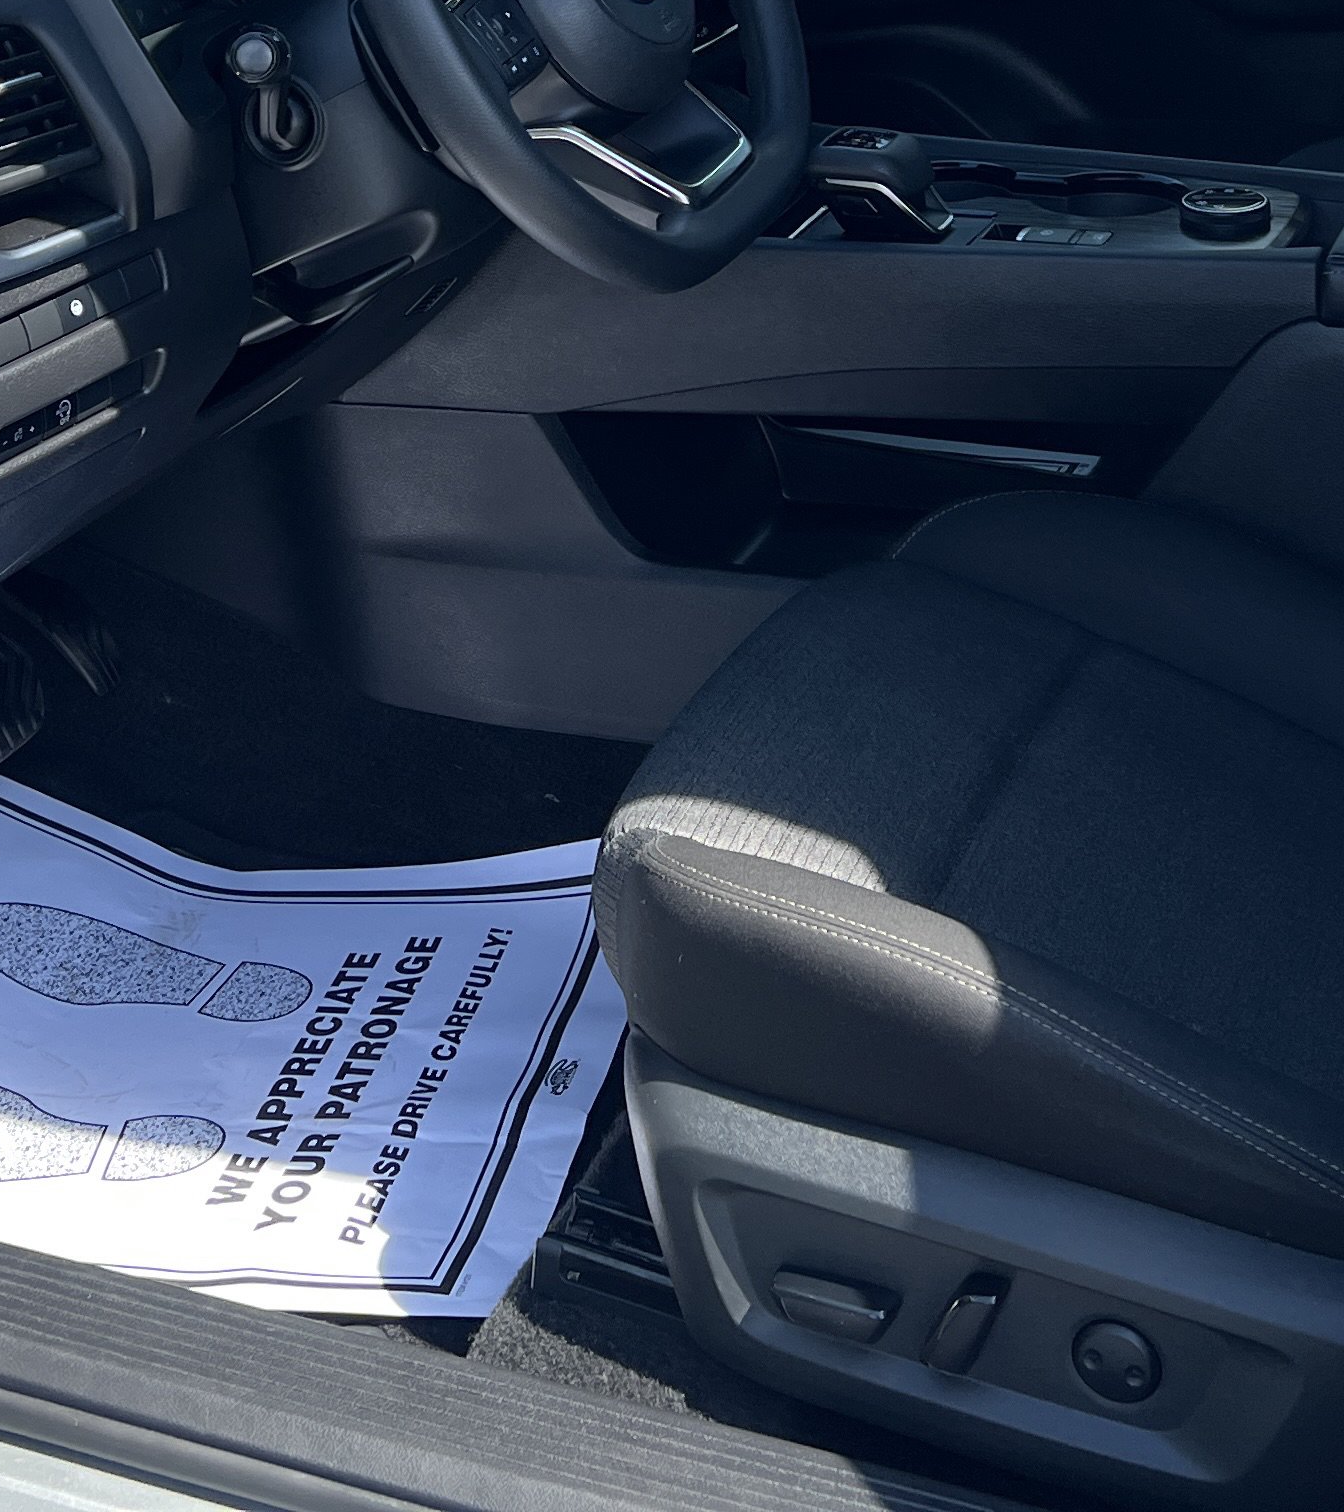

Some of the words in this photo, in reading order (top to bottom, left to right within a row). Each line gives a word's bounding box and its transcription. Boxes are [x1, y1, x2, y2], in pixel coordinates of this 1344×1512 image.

[205, 1153, 269, 1205] WE
[246, 952, 382, 1146] APPRECIATE
[253, 1133, 341, 1231] YOUR
[314, 936, 443, 1120] PATRONAGE
[337, 1144, 410, 1245] PLEASE
[391, 1066, 449, 1139] DRIVE
[430, 927, 513, 1061] CAREFULLY!
